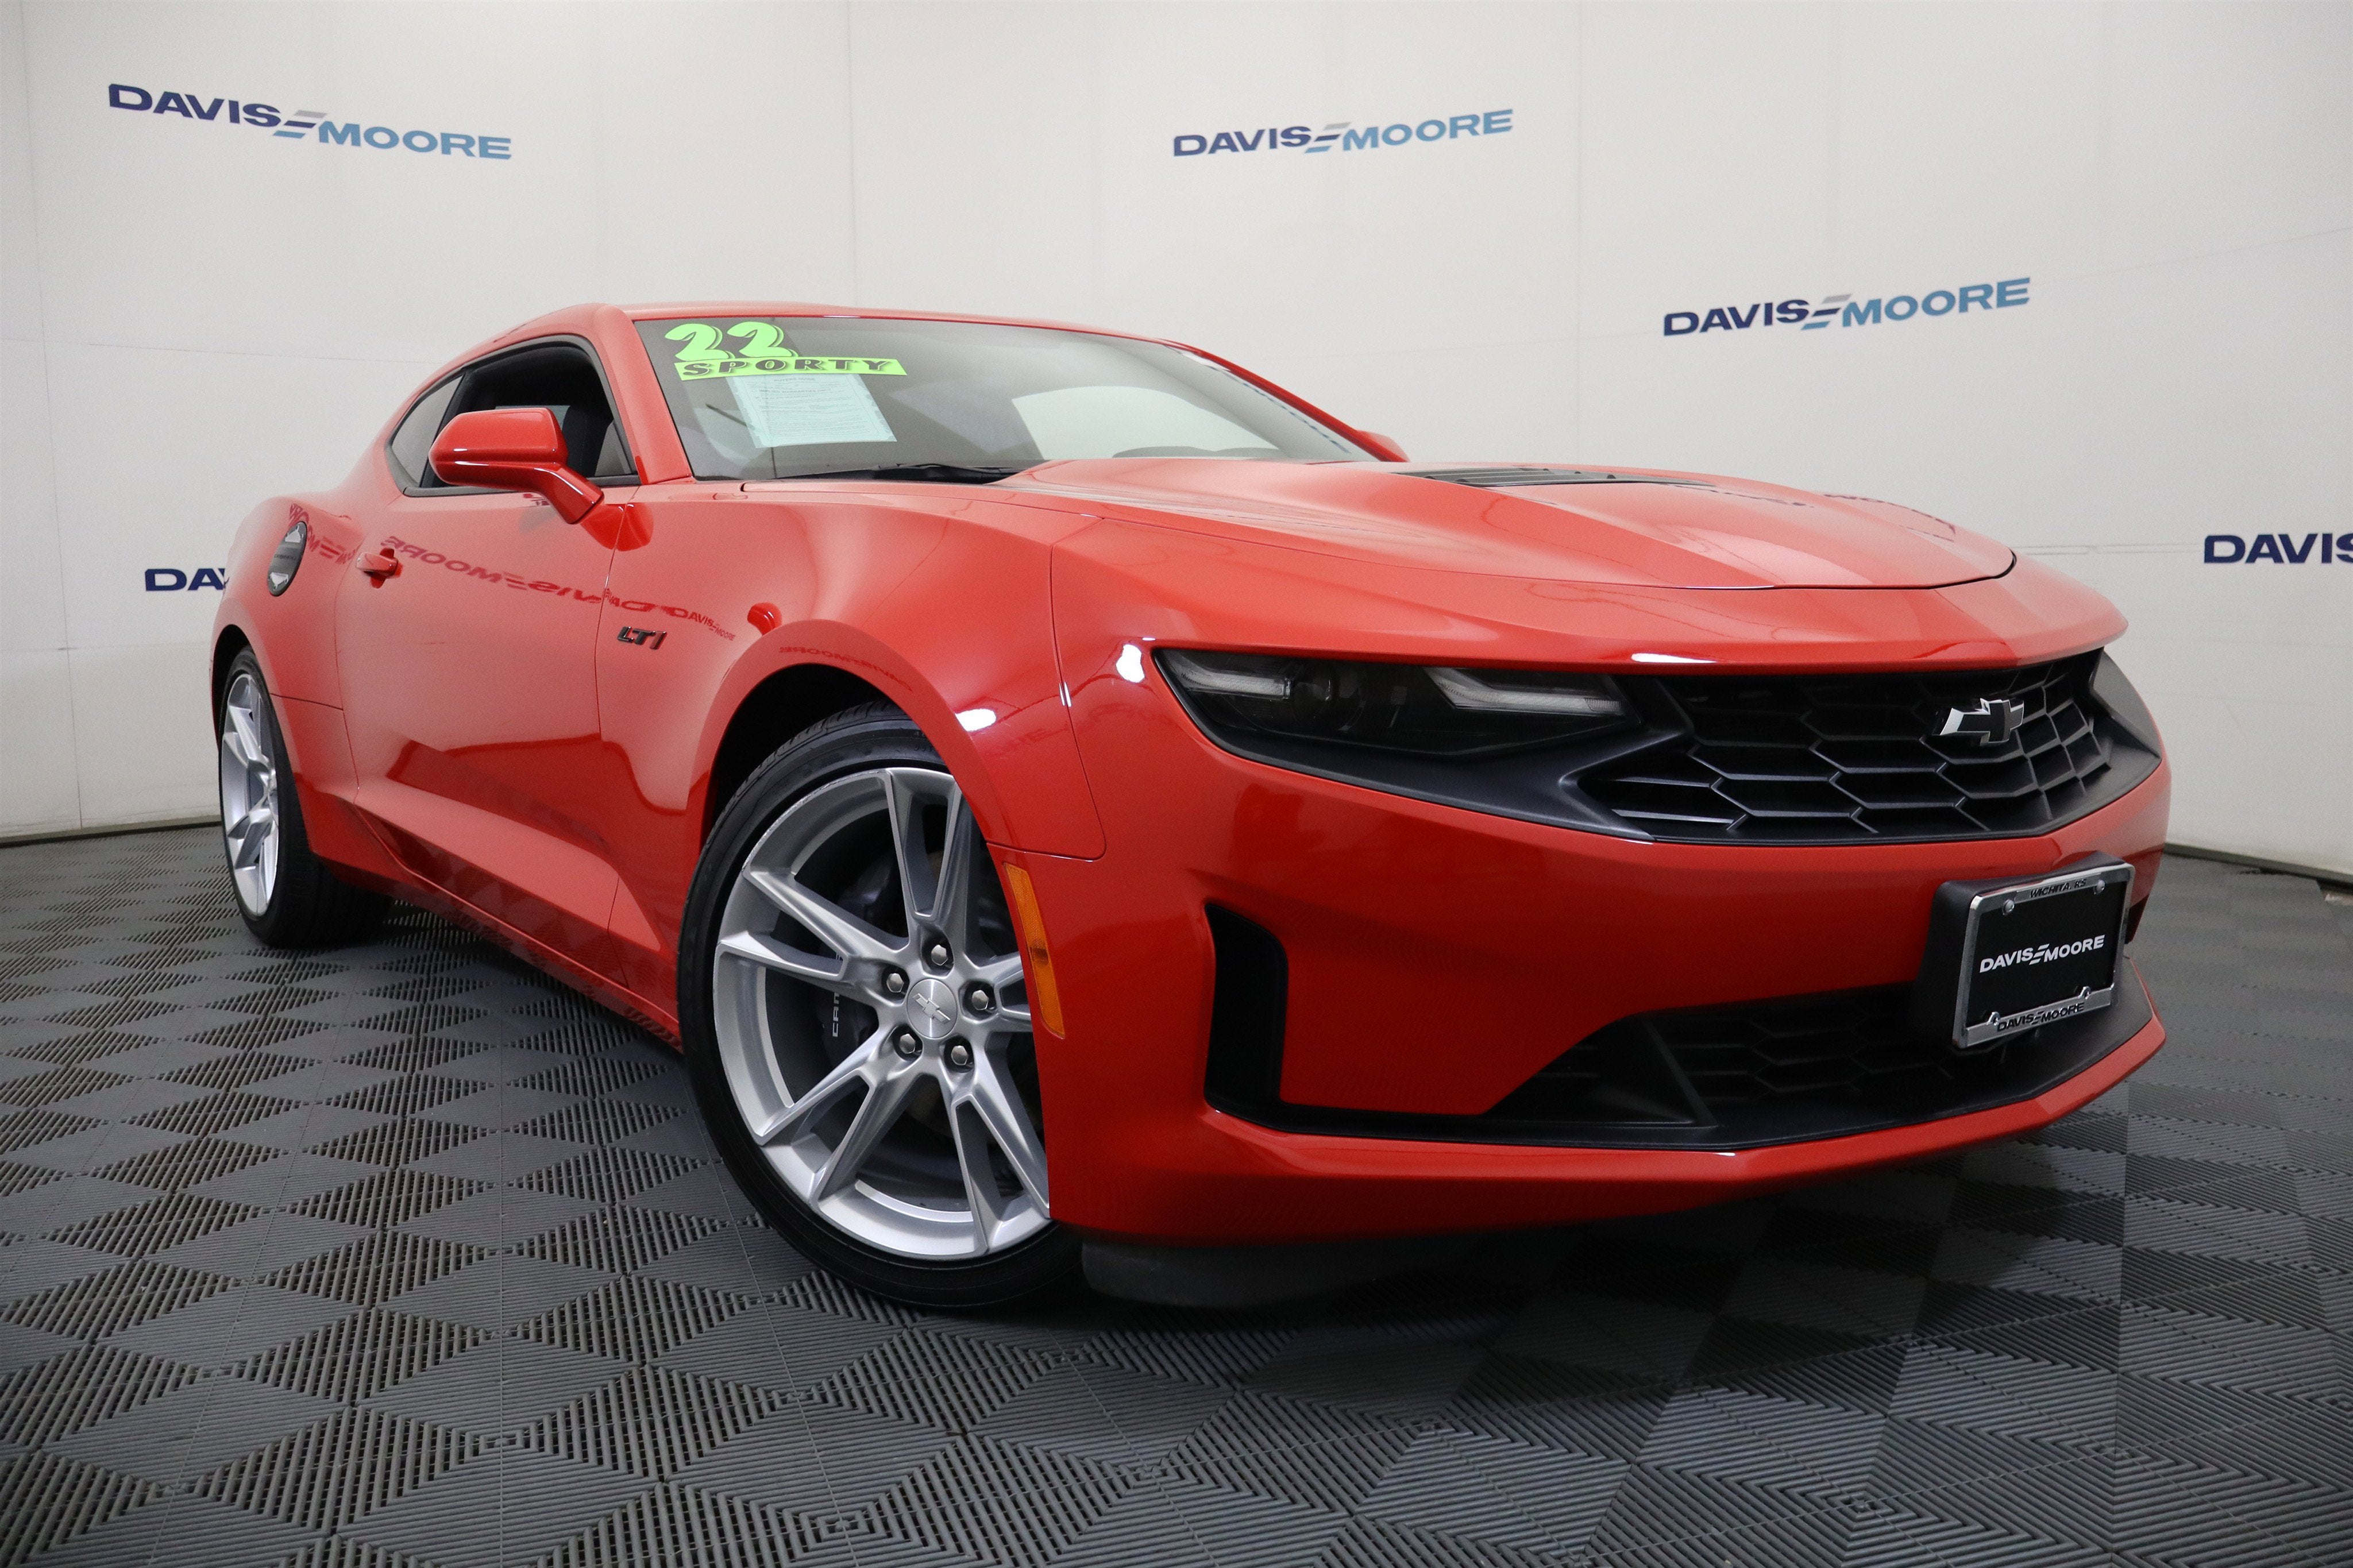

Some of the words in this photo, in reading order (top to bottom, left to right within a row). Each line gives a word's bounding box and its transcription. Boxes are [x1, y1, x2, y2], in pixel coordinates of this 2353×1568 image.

[109, 83, 281, 128] DAVIS
[318, 121, 512, 160] MOORE
[1173, 126, 1311, 157] DAVIS
[1343, 109, 1513, 151] MOORE
[1664, 299, 1809, 336] DAVIS
[1842, 277, 2030, 328] MOORE
[665, 321, 799, 361] 22
[682, 359, 891, 376] SPORTY
[1980, 948, 2034, 973] DAVIS
[2044, 934, 2105, 963] MOORE
[1997, 1013, 2035, 1032] DAVIS
[2040, 1002, 2085, 1023] MOORE
